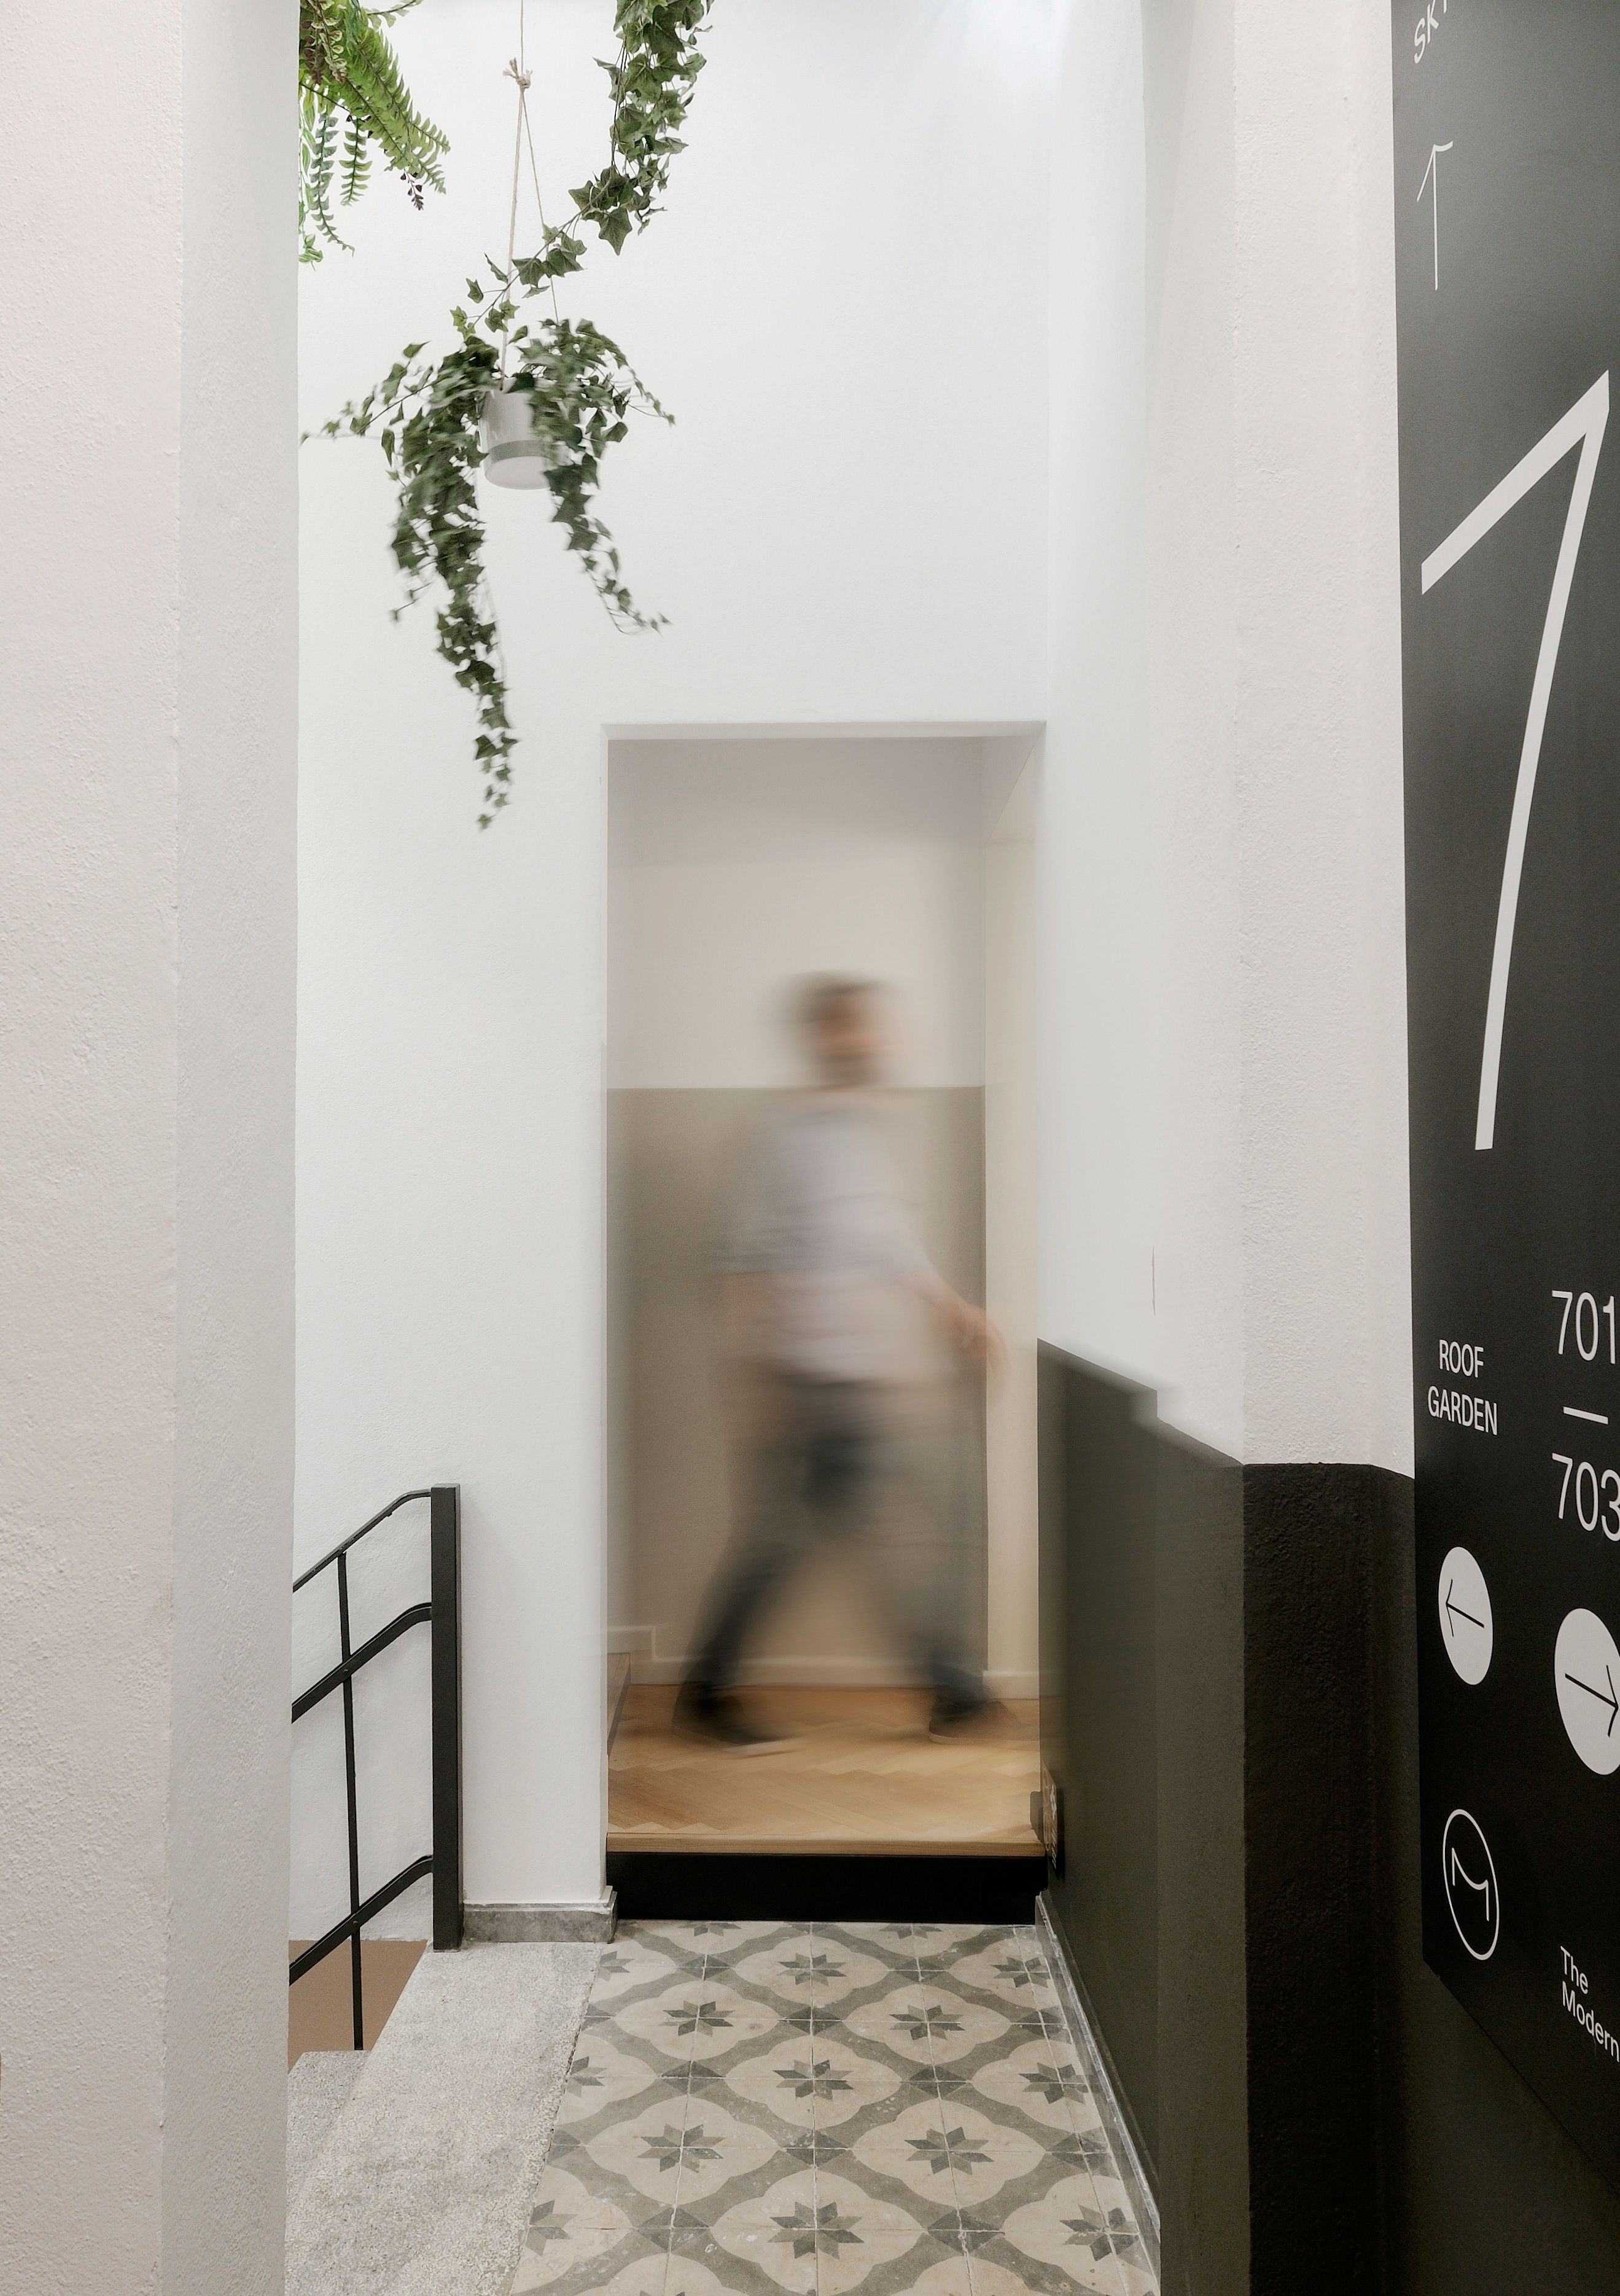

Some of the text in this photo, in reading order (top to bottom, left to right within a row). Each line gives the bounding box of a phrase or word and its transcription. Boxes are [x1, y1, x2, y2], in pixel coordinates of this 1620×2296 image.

[1421, 369, 1610, 1150] 7
[1439, 1339, 1484, 1378] ROOF
[1551, 1290, 1616, 1365] 701
[1428, 1386, 1498, 1435] GARDEN
[1551, 1452, 1620, 1542] 703
[1560, 1945, 1589, 1994] The
[1562, 1980, 1620, 2063] Modern
